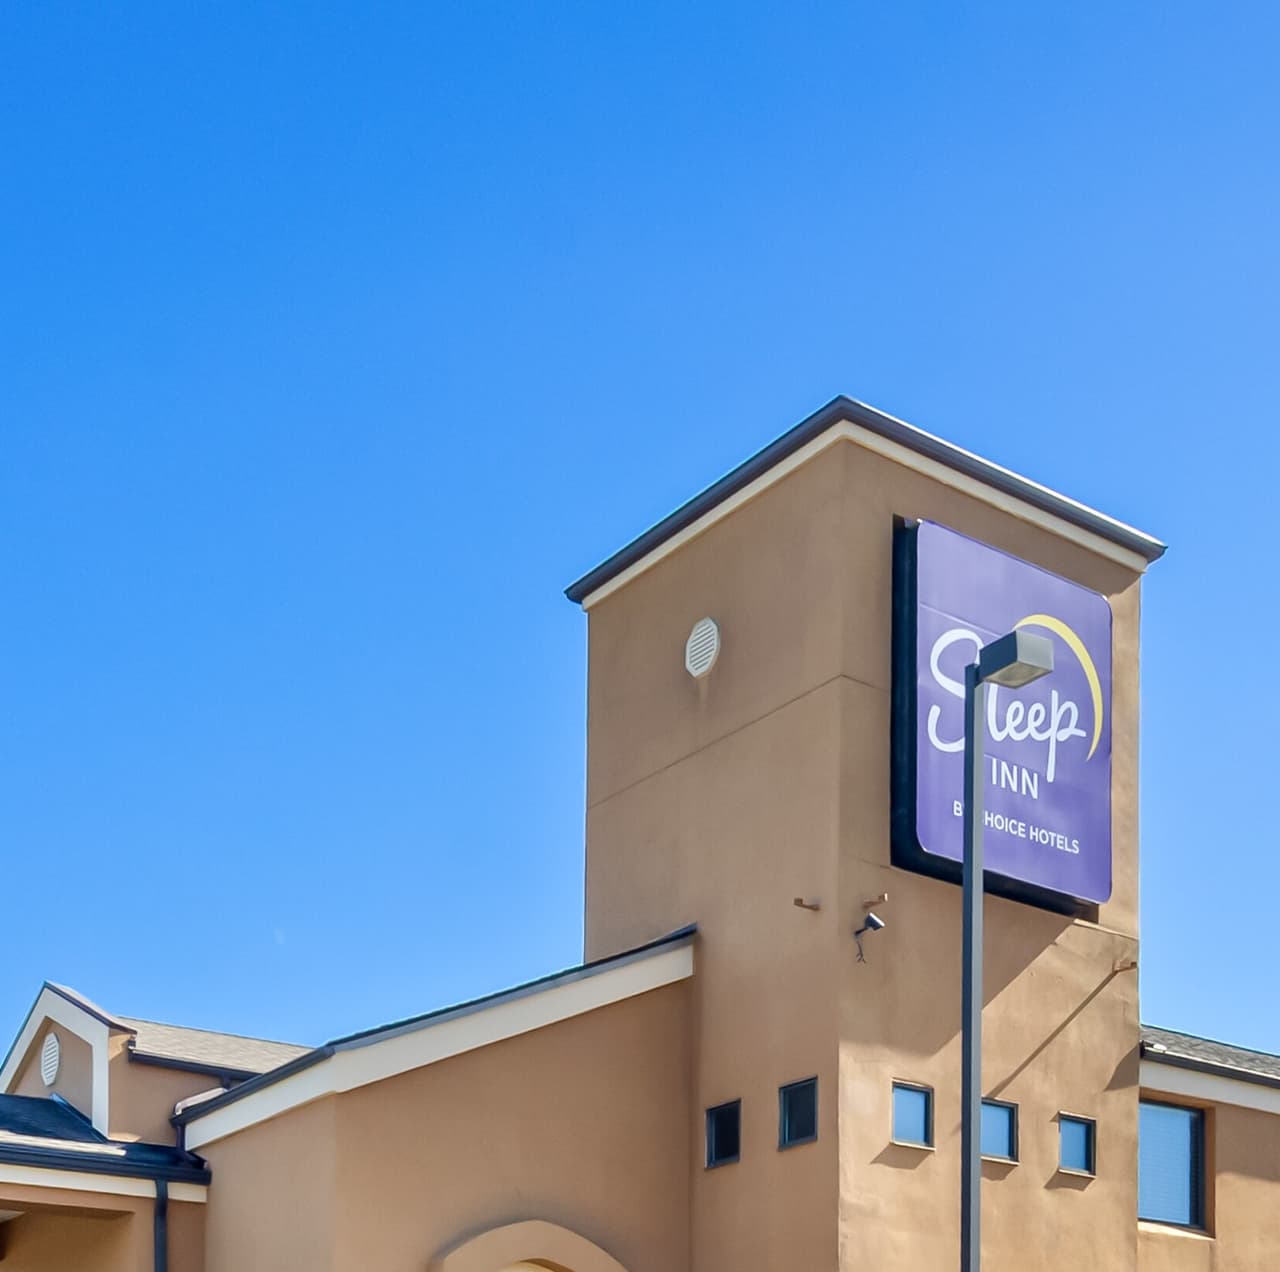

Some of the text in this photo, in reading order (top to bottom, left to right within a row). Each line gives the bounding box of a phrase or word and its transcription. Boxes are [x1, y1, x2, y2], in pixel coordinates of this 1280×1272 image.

[927, 628, 1087, 783] Sleep
[992, 758, 1039, 799] INN
[984, 811, 1026, 838] HOICE
[1029, 825, 1080, 854] HOTELS
